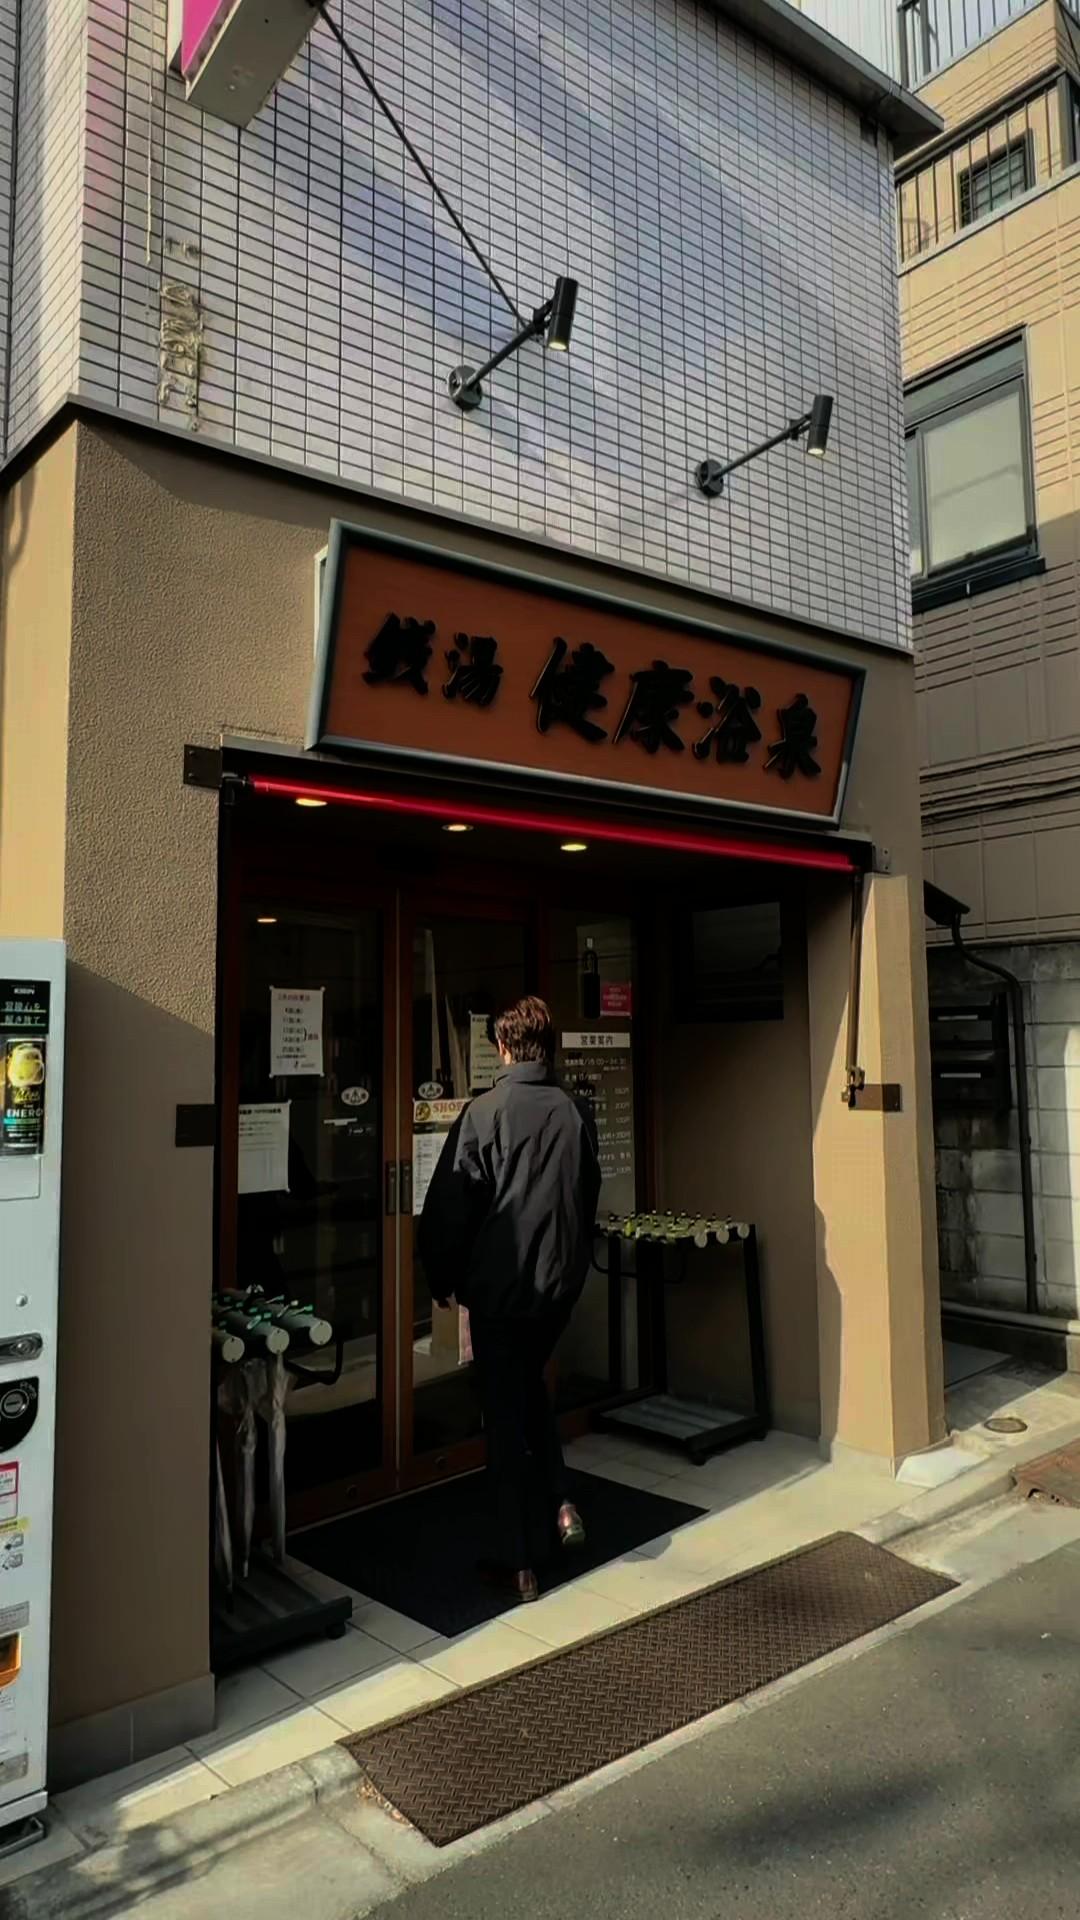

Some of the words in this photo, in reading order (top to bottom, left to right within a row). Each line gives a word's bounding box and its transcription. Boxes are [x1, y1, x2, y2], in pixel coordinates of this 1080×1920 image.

[362, 611, 504, 707] 銭湯
[528, 635, 823, 780] 健康浴泉
[580, 1035, 613, 1046] 営業案内
